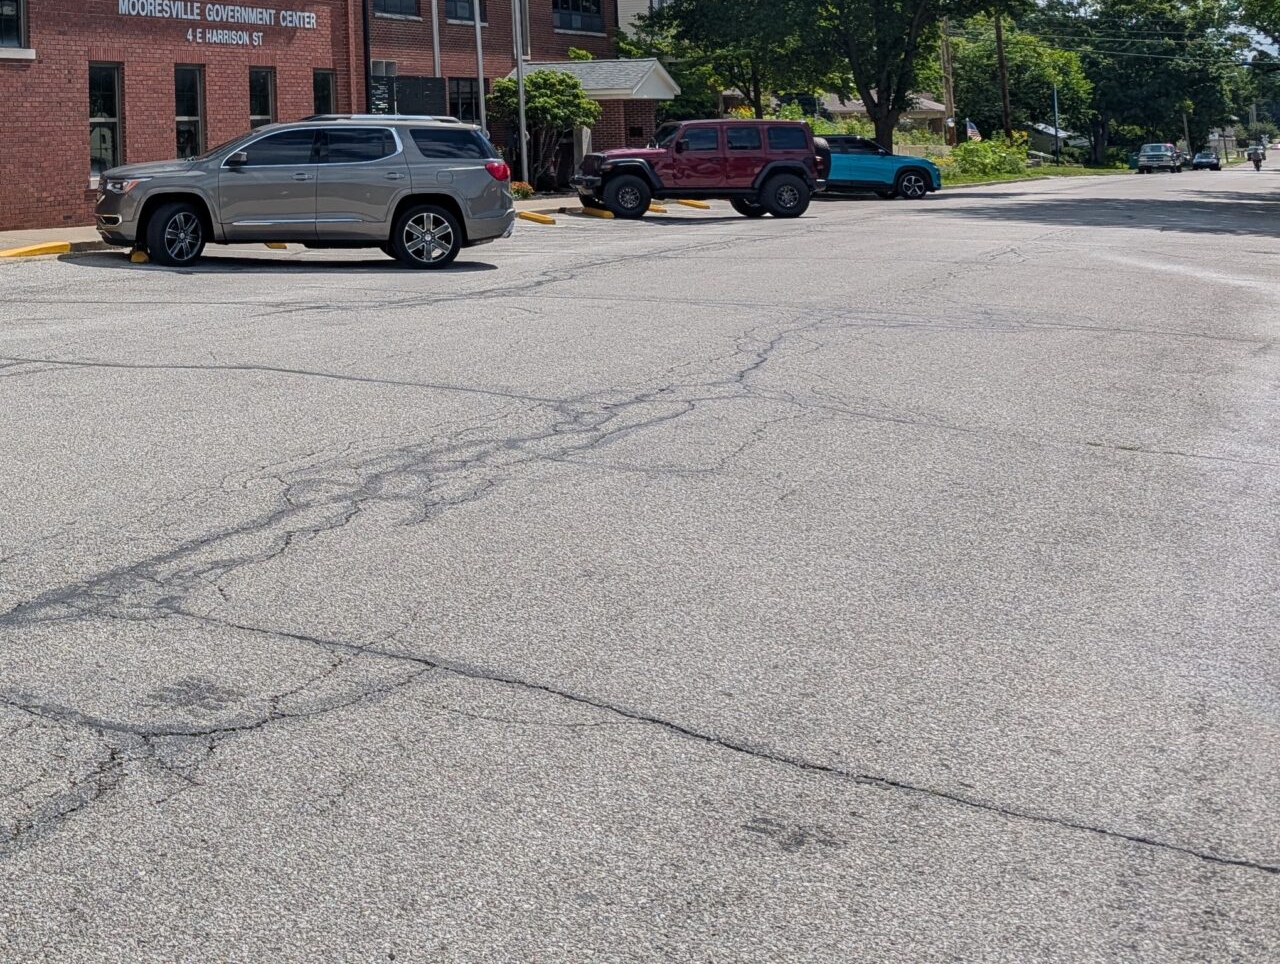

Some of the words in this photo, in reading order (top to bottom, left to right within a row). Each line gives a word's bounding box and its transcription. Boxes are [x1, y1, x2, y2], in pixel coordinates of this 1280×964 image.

[205, 3, 276, 25] GOVERNMENT
[280, 10, 317, 29] CENTER
[187, 28, 193, 42] 4
[196, 29, 202, 43] E
[206, 29, 249, 45] HARRISON
[253, 32, 263, 46] ST
